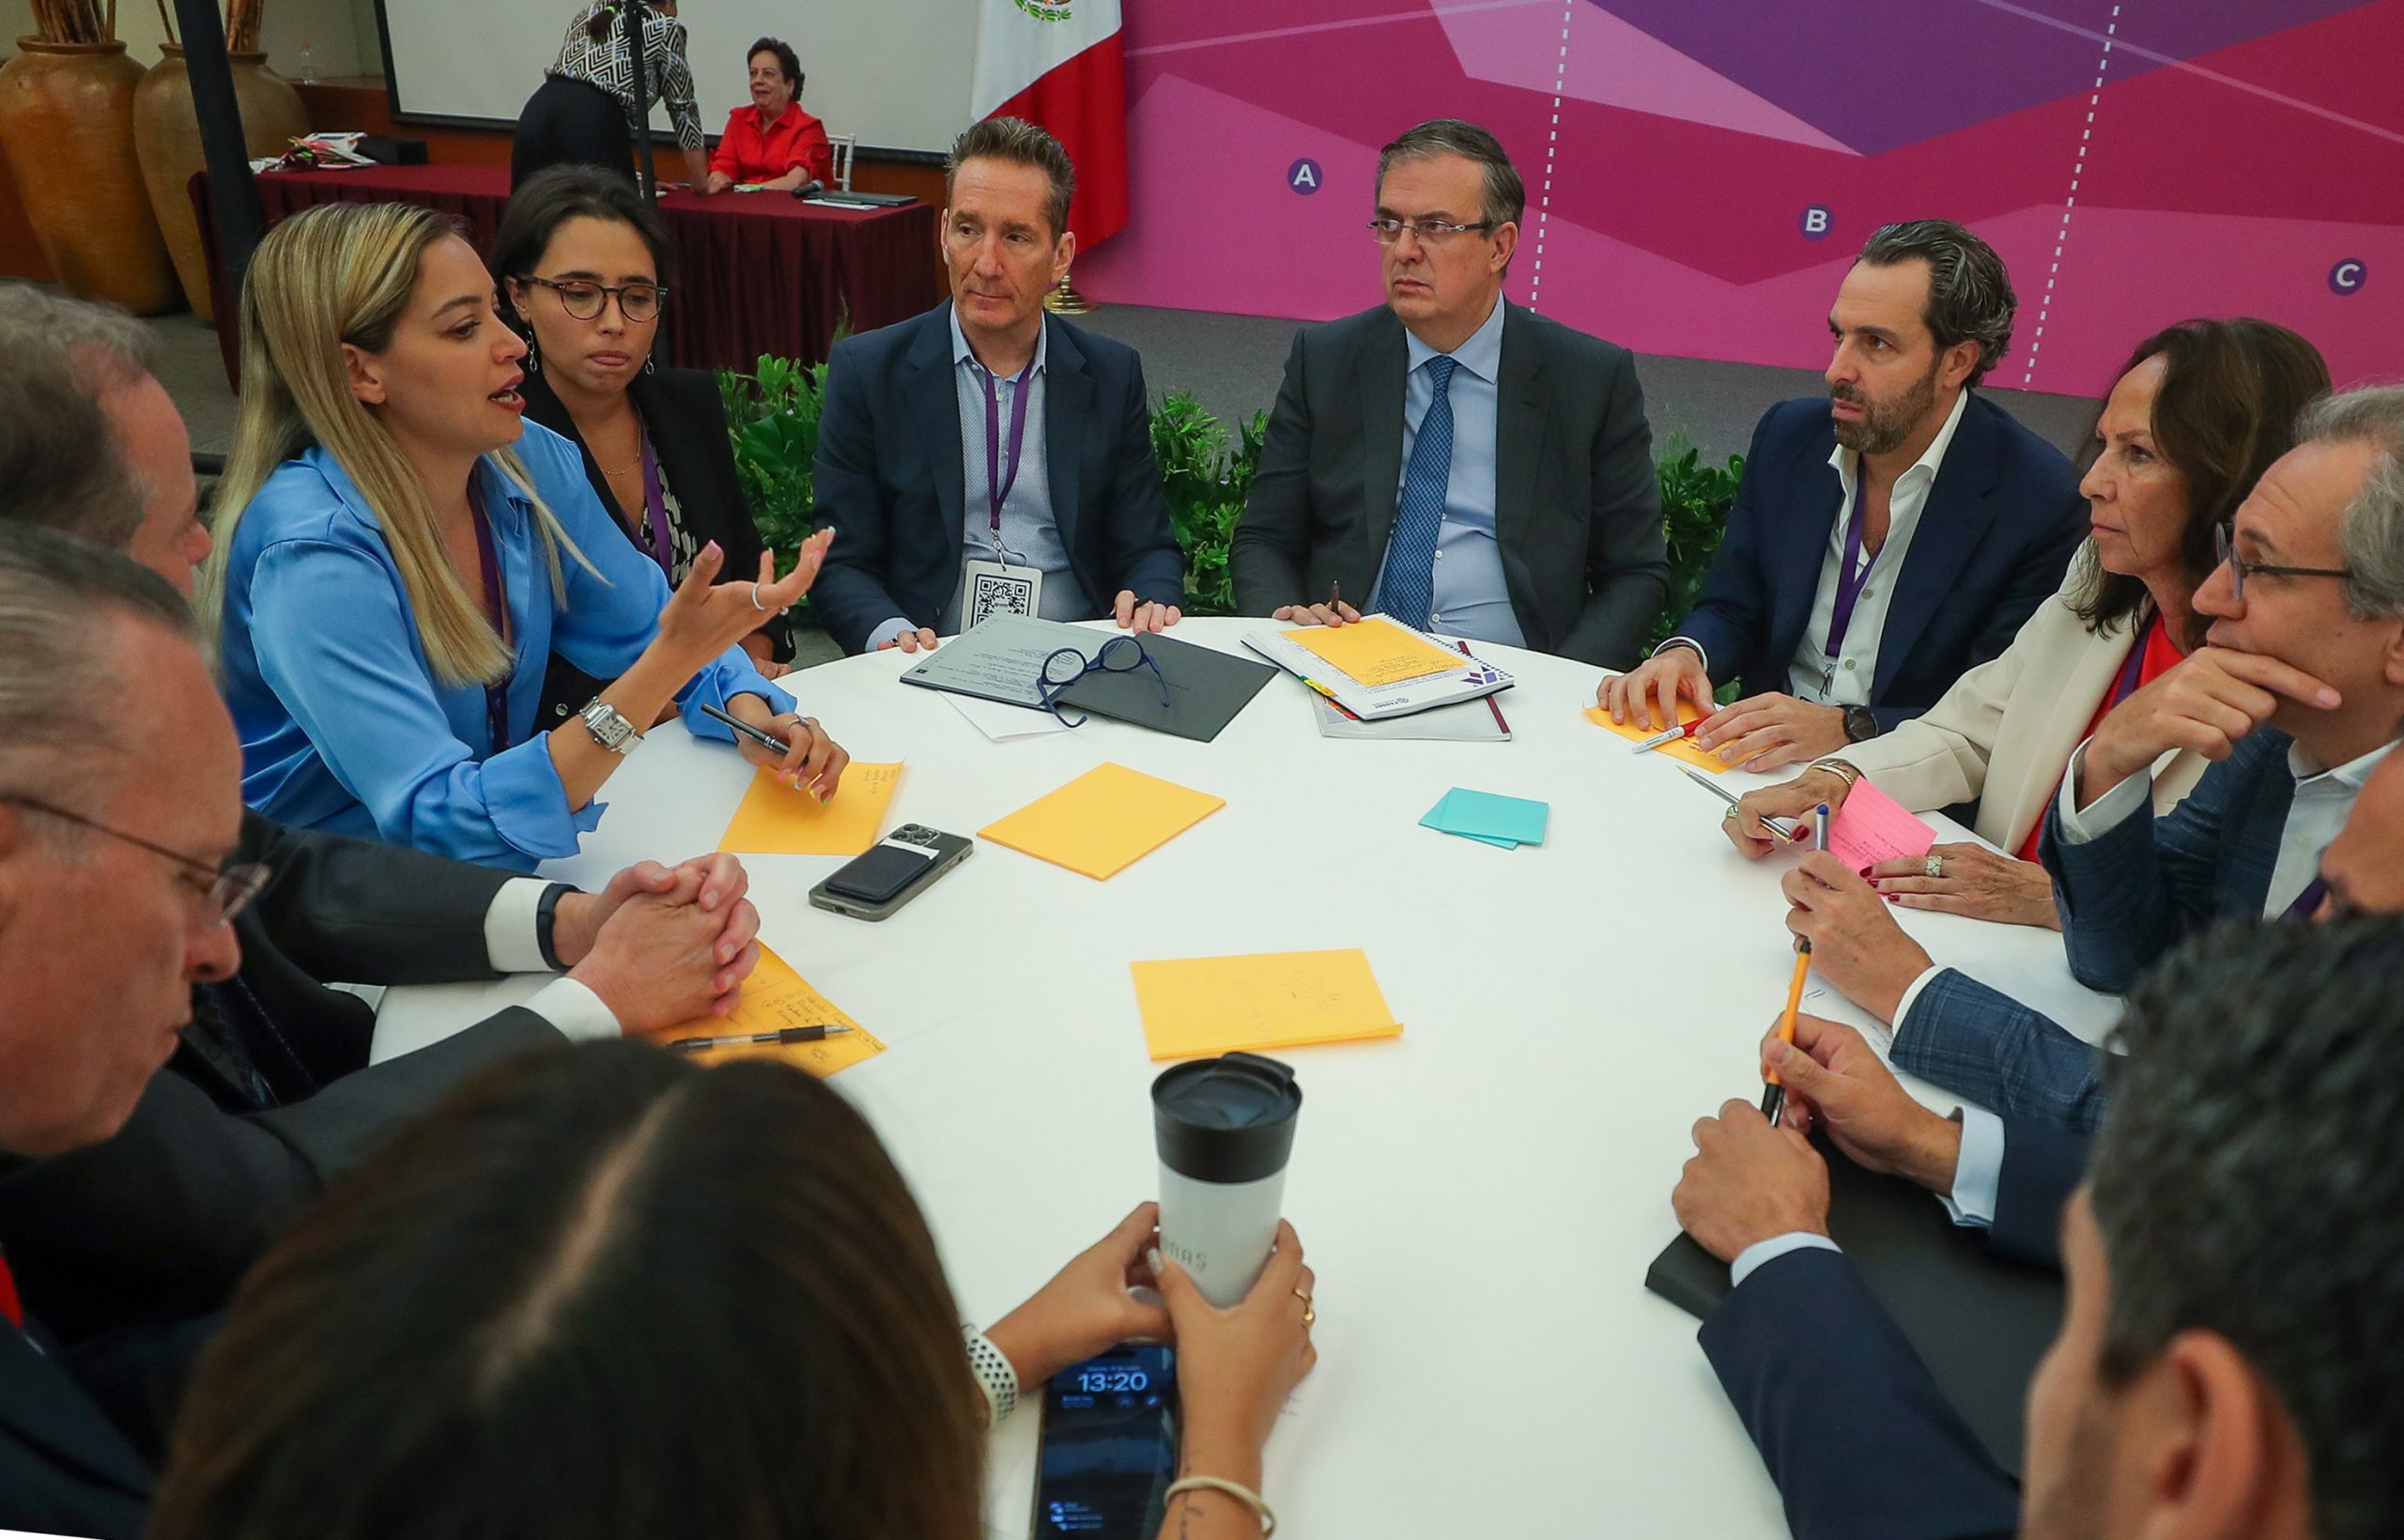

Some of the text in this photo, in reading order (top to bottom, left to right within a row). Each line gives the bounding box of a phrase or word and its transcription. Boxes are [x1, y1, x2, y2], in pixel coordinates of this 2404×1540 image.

[1293, 163, 1317, 187] A
[1806, 208, 1827, 232] B
[2336, 263, 2360, 286] C
[1077, 1371, 1148, 1392] 13:20
